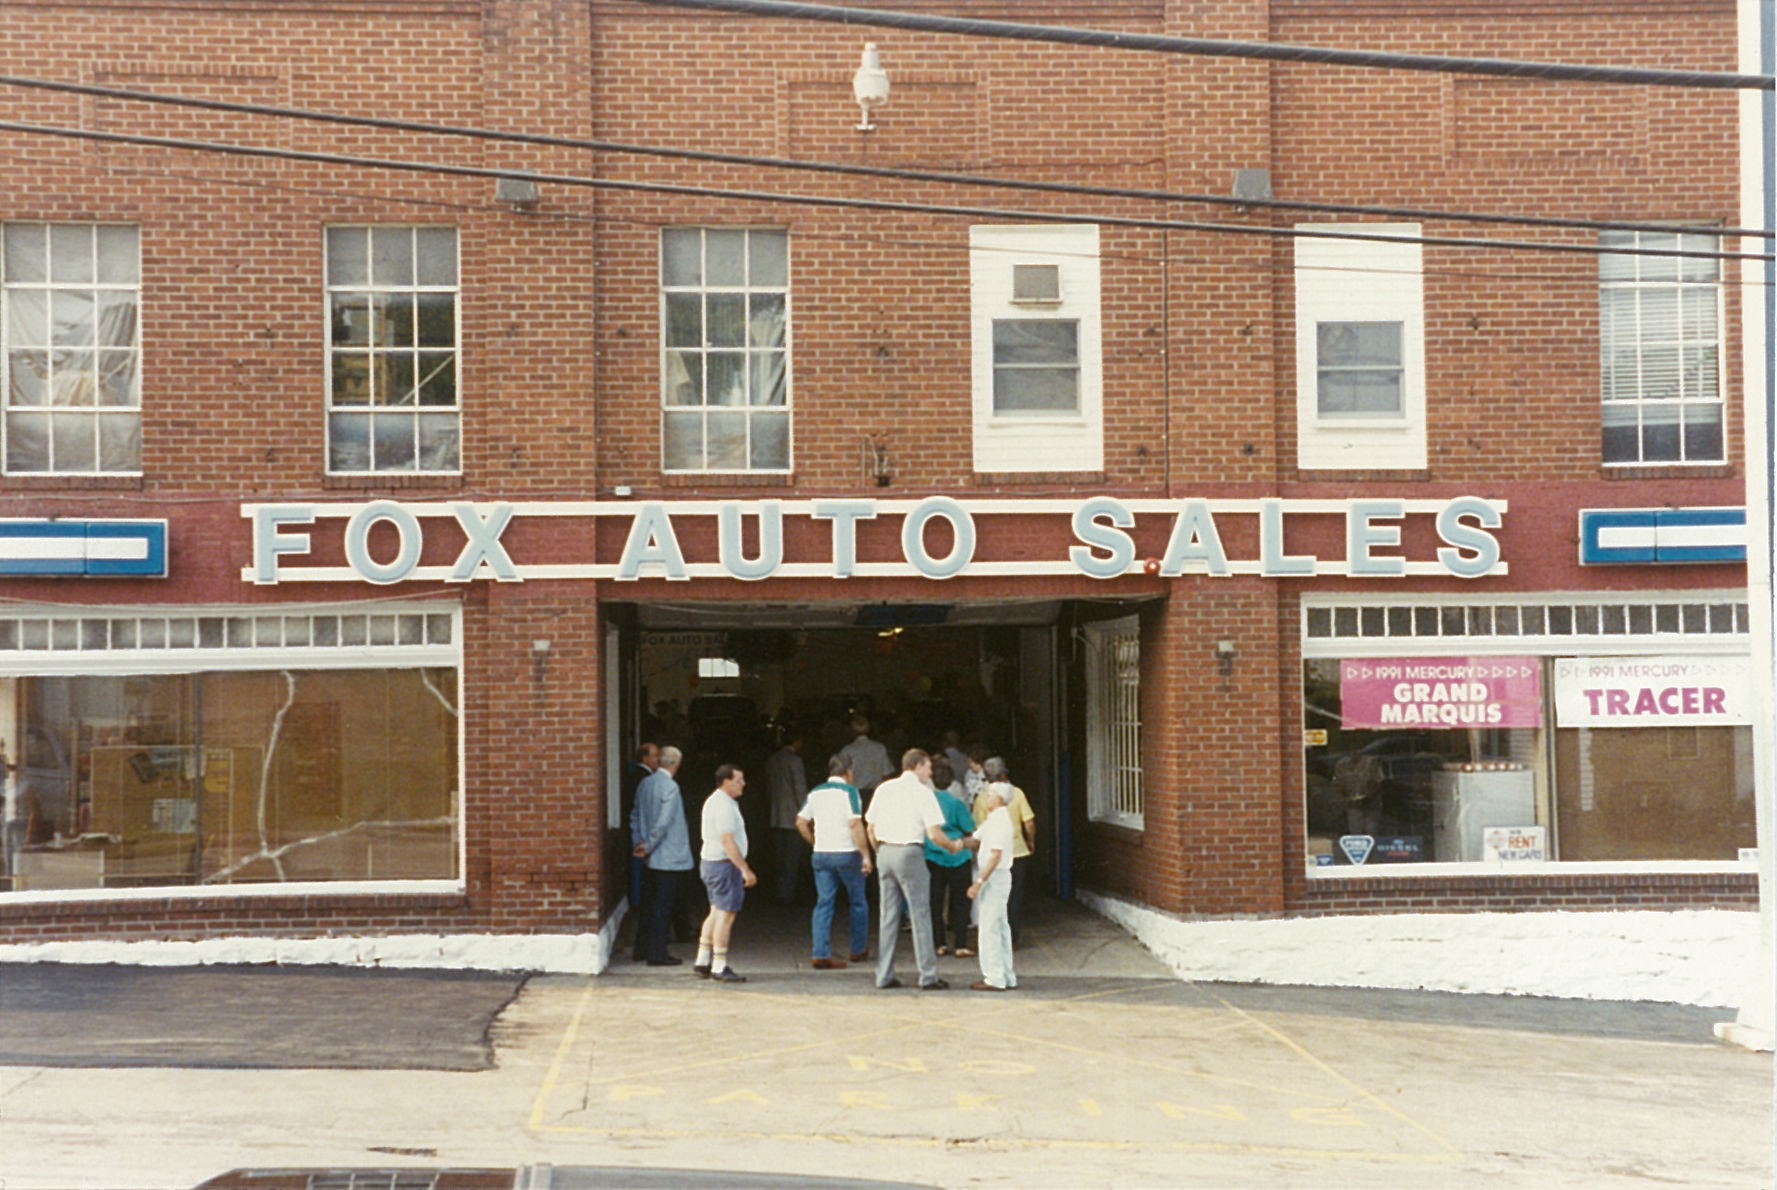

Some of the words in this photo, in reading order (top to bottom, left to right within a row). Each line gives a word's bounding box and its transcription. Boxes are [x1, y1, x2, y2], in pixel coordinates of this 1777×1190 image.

[253, 499, 522, 585] FOX
[615, 496, 977, 582] AUTO
[1068, 496, 1503, 579] SALES
[669, 635, 702, 646] AUTO
[1376, 666, 1402, 679] 1991
[1406, 666, 1475, 679] MERCURY
[1589, 666, 1615, 678] 1991
[1619, 664, 1689, 678] MERCURY
[1393, 683, 1488, 703] GRAND
[1583, 687, 1727, 716] TRACER
[1381, 703, 1503, 725] MARQUIS
[1508, 835, 1536, 849] RENT
[847, 1056, 1036, 1075] NO
[608, 1084, 1365, 1126] PARKING
